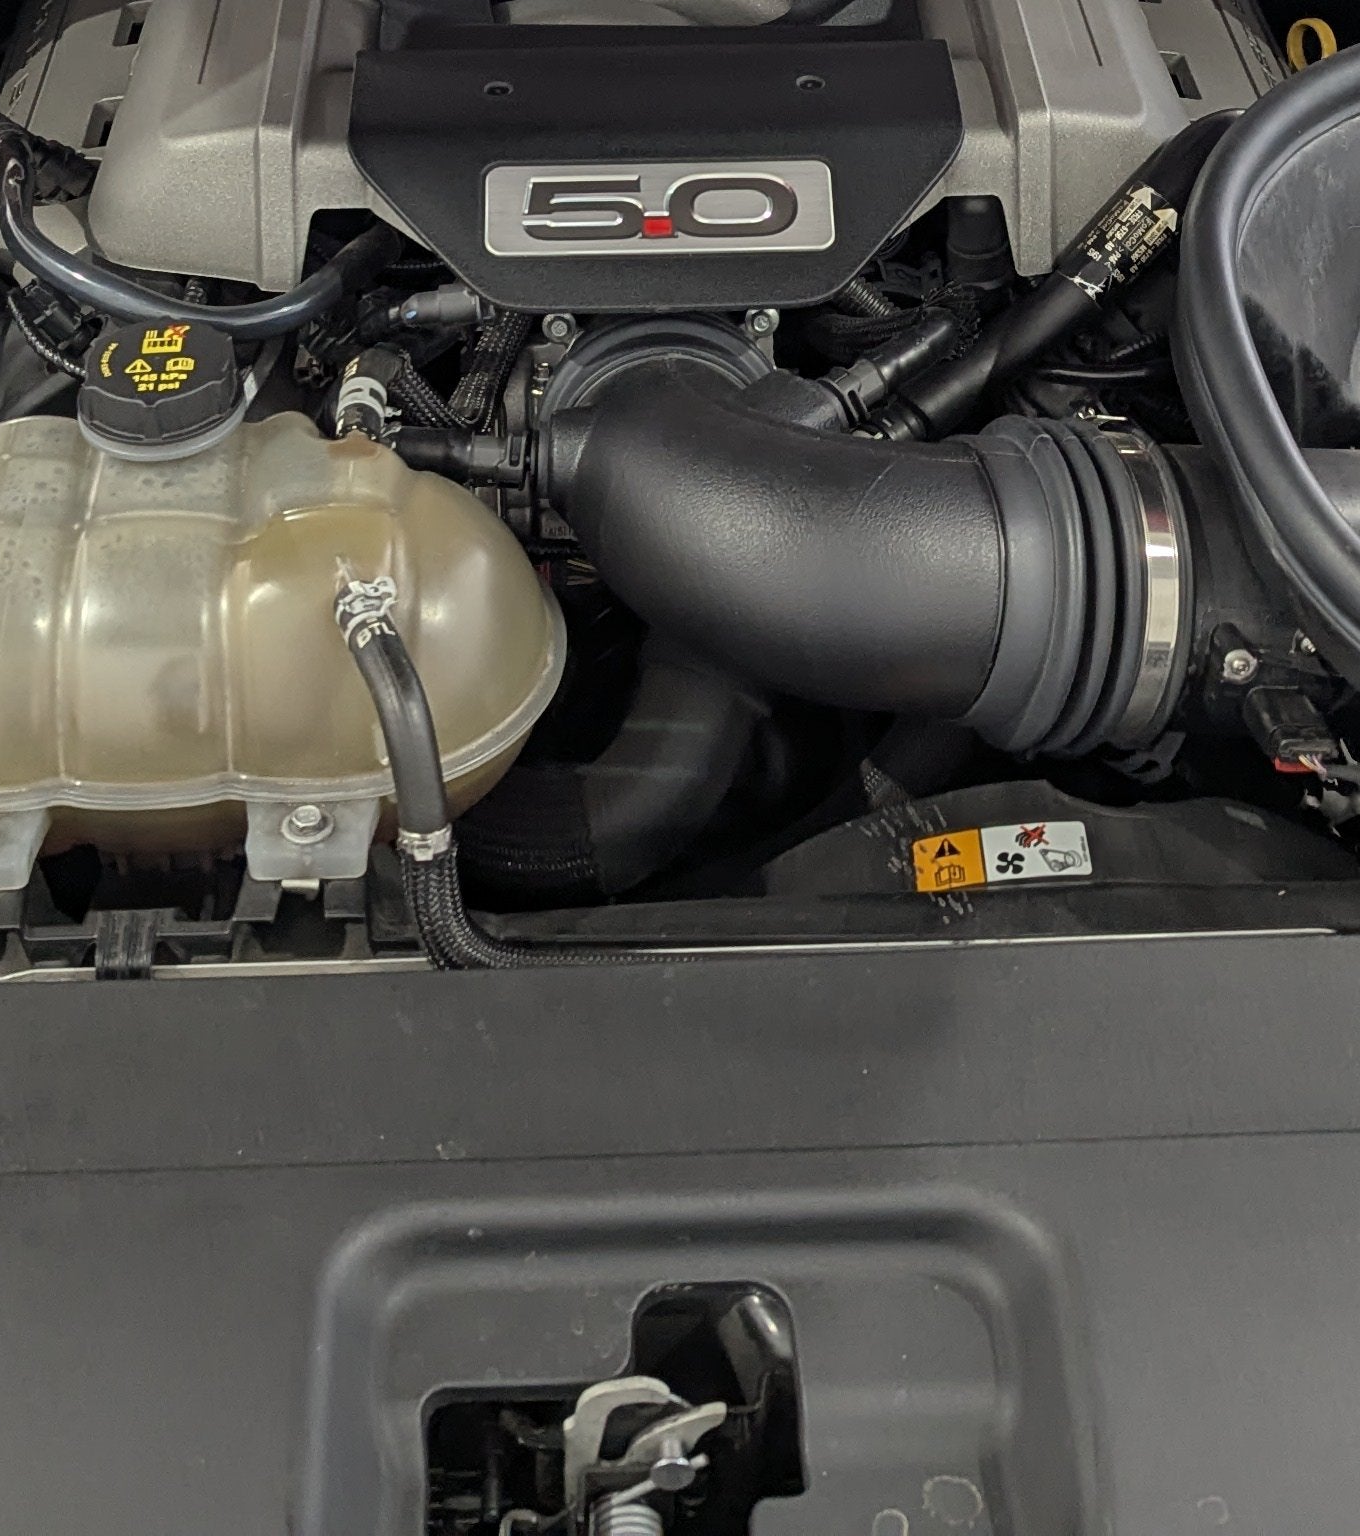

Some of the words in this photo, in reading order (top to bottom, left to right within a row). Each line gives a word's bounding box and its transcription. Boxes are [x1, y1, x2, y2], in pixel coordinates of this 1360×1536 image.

[521, 171, 799, 241] 5.0
[131, 373, 158, 382] 145
[160, 372, 188, 381] kPa
[136, 382, 155, 392] 21
[157, 381, 180, 392] psi
